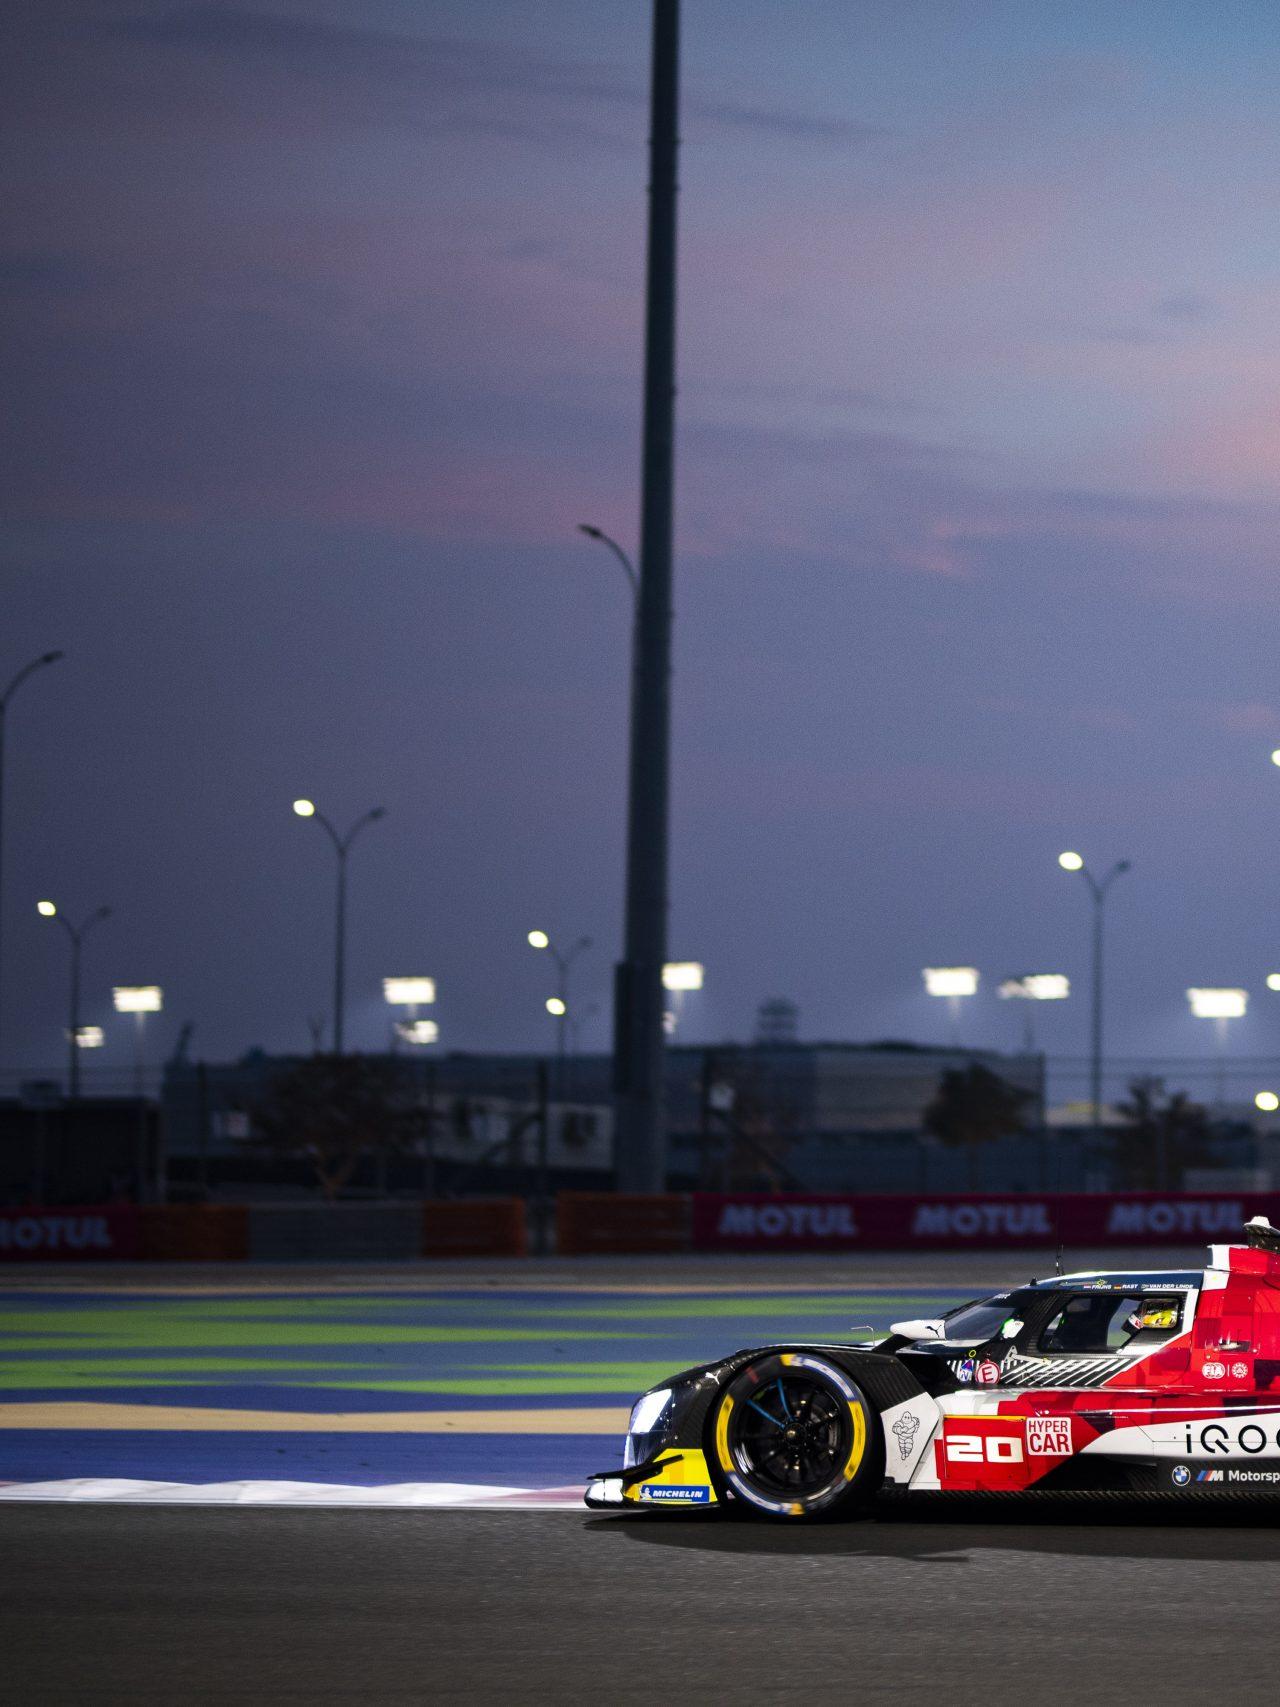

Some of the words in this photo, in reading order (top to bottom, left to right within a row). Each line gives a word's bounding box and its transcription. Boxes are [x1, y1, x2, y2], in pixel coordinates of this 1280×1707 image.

[718, 1204, 858, 1237] MOTUL
[912, 1203, 1053, 1236] MOTUL
[1107, 1202, 1247, 1235] MOTUL
[981, 1366, 994, 1383] E
[1028, 1420, 1069, 1433] HYPER
[945, 1435, 1025, 1463] 20
[1029, 1433, 1070, 1453] CAR
[652, 1489, 704, 1499] MICHELIN
